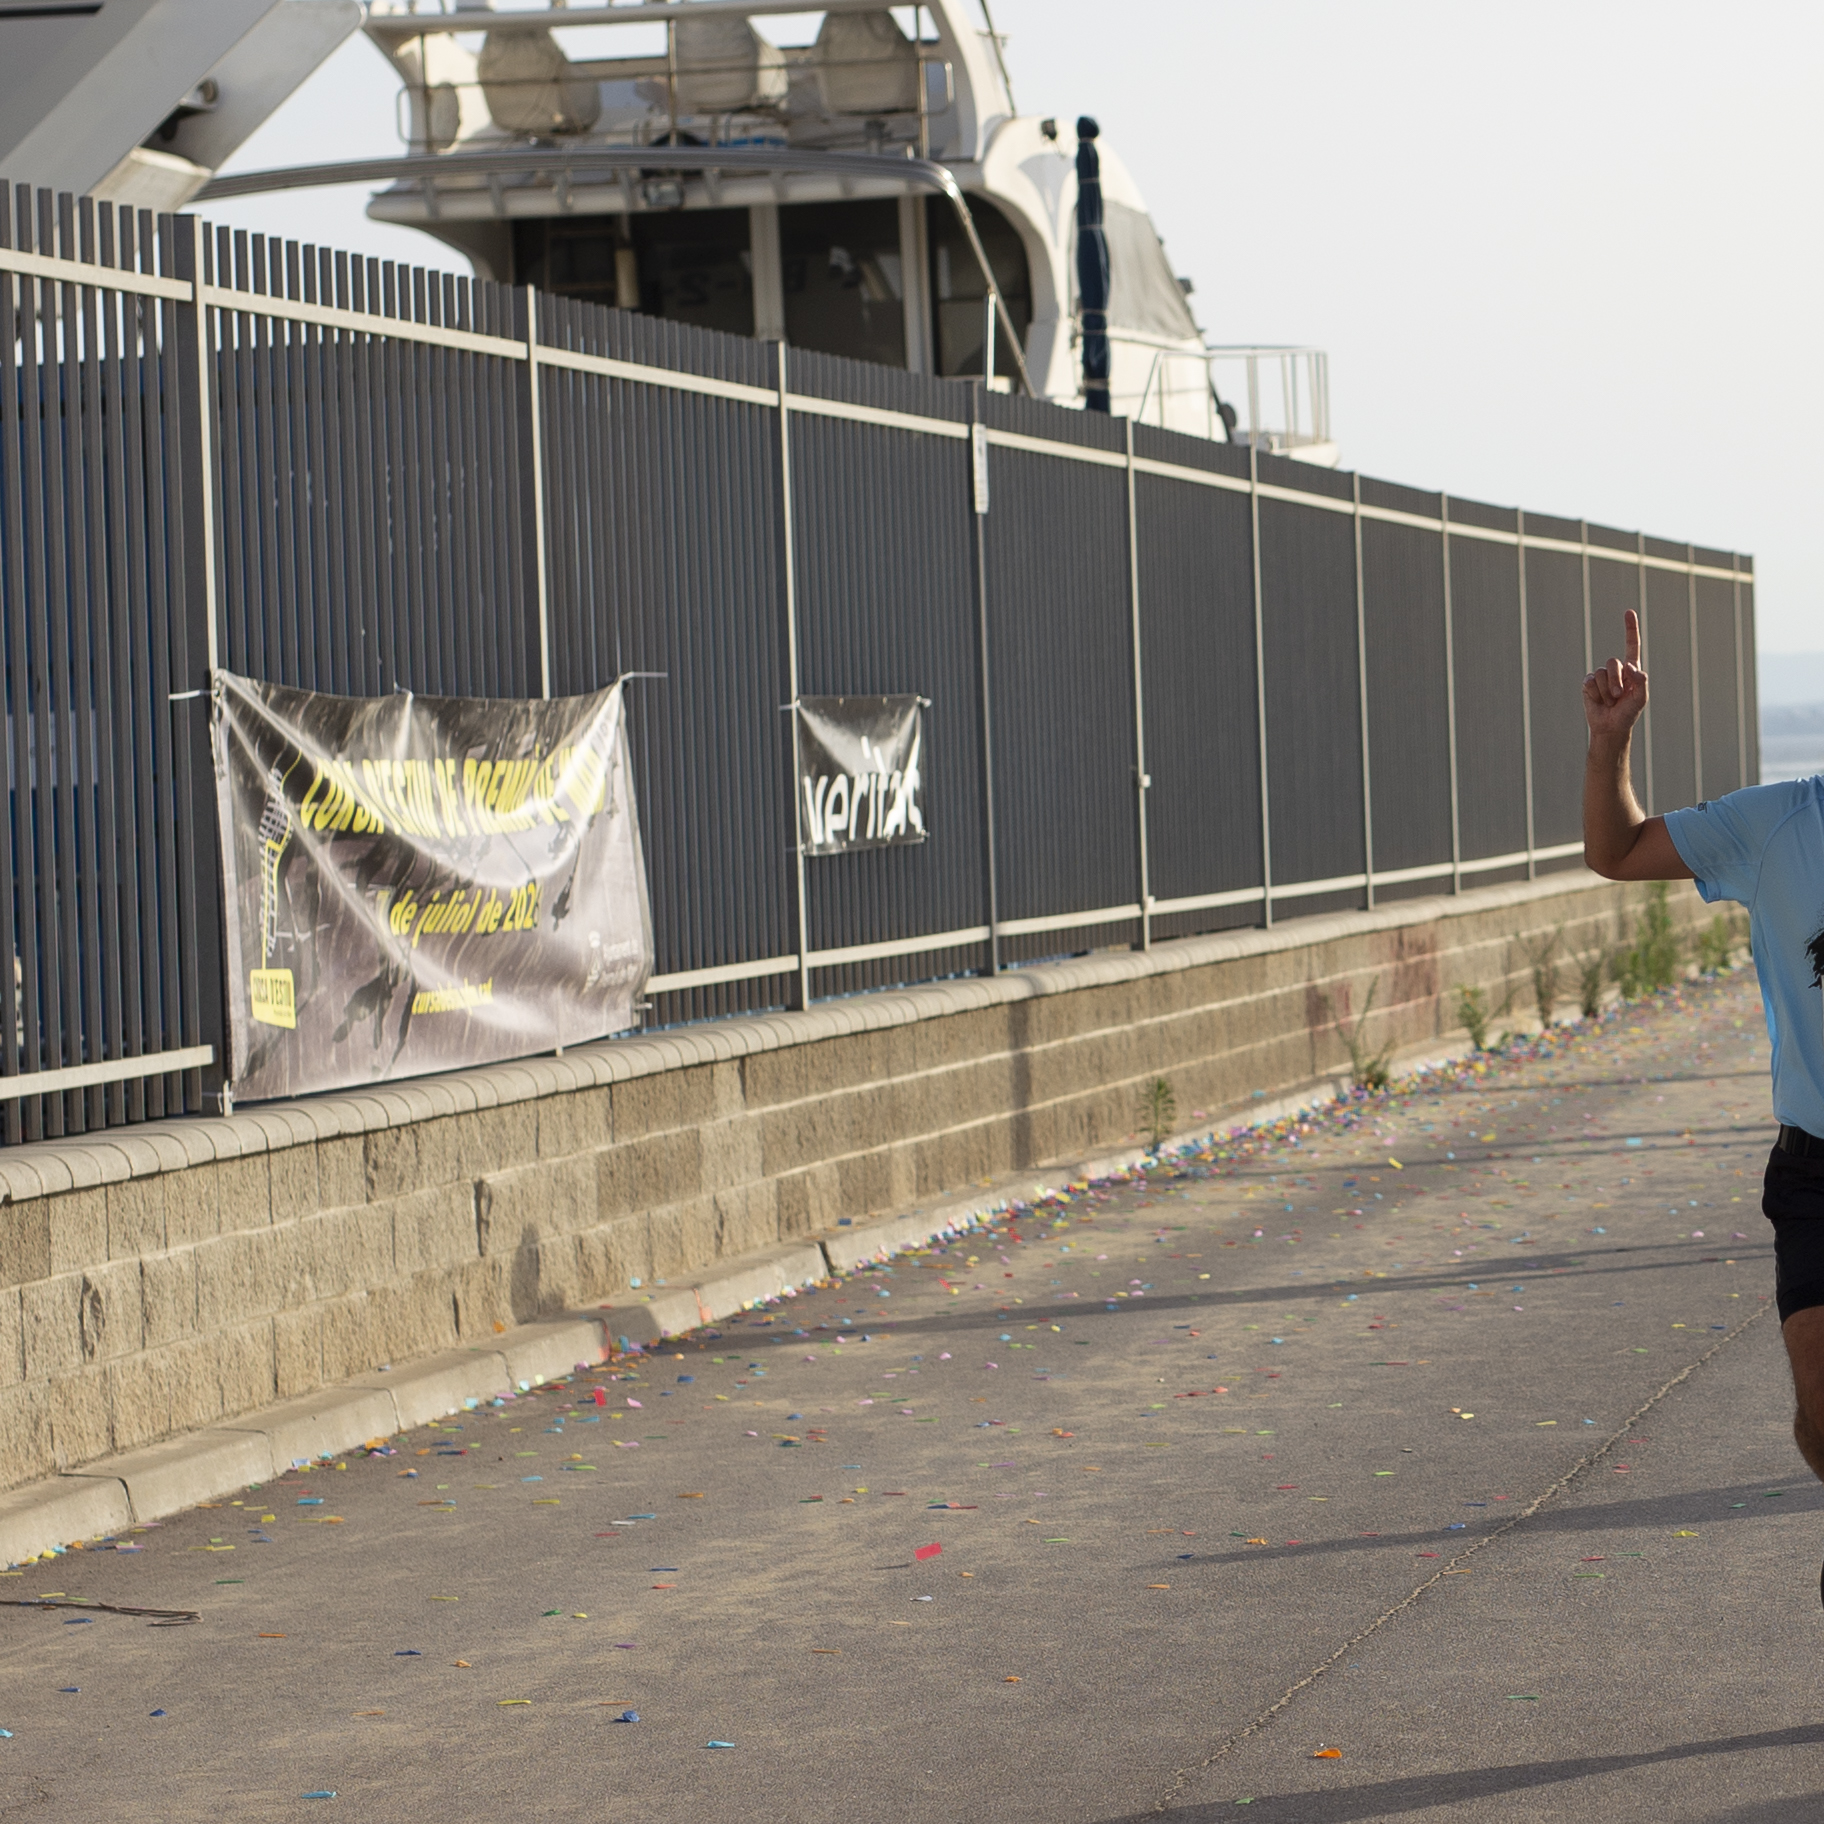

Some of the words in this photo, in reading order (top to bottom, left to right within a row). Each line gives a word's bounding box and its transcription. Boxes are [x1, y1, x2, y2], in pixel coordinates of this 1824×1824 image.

[389, 889, 418, 936] de
[411, 888, 482, 949] juliol
[475, 888, 503, 934] de
